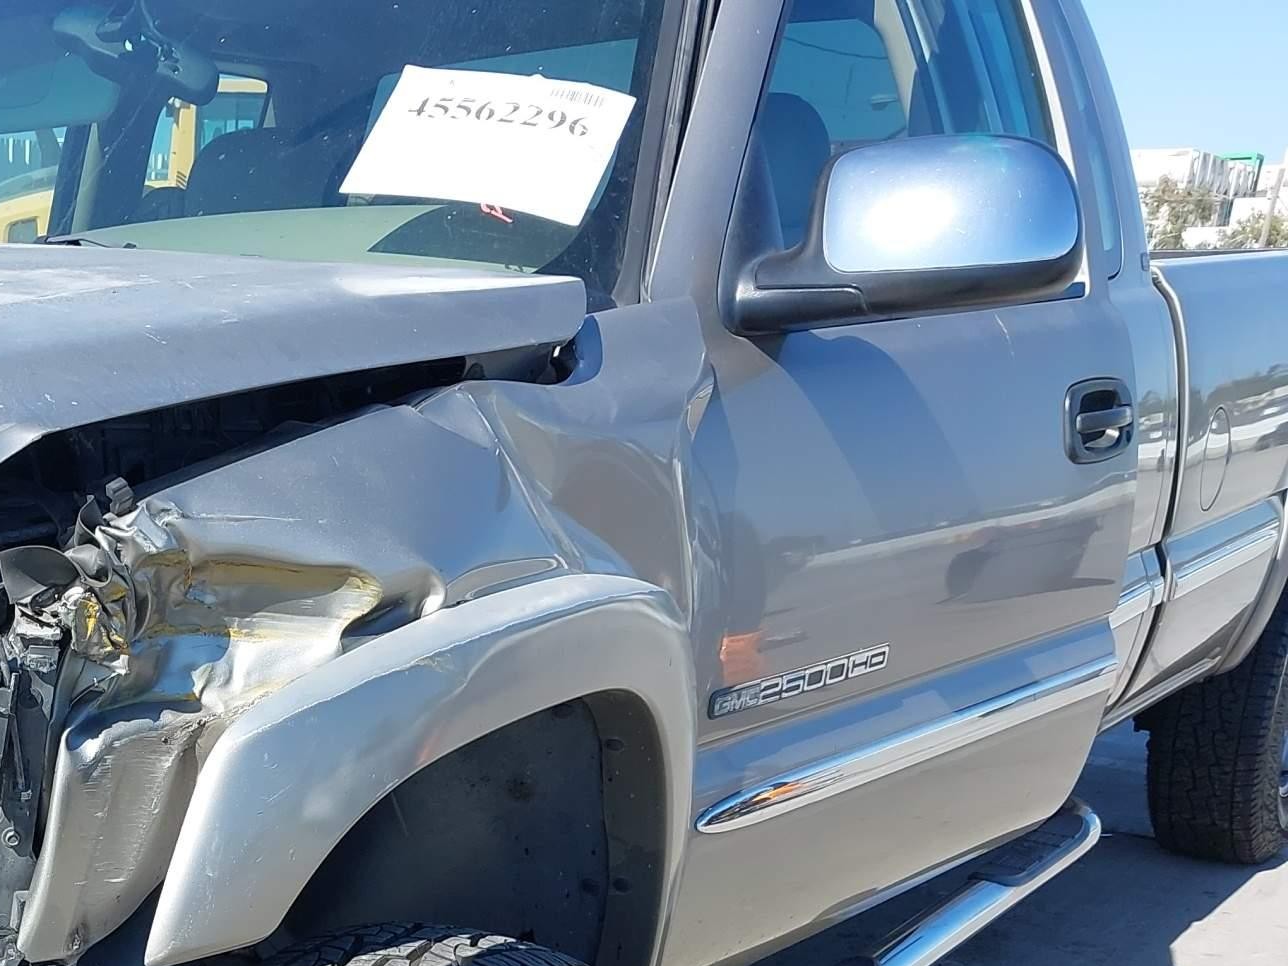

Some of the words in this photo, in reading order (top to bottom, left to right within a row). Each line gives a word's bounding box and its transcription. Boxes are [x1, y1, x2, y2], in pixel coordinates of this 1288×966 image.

[408, 96, 589, 137] 45562296
[713, 687, 760, 717] GMC
[759, 645, 890, 705] 2500HD
